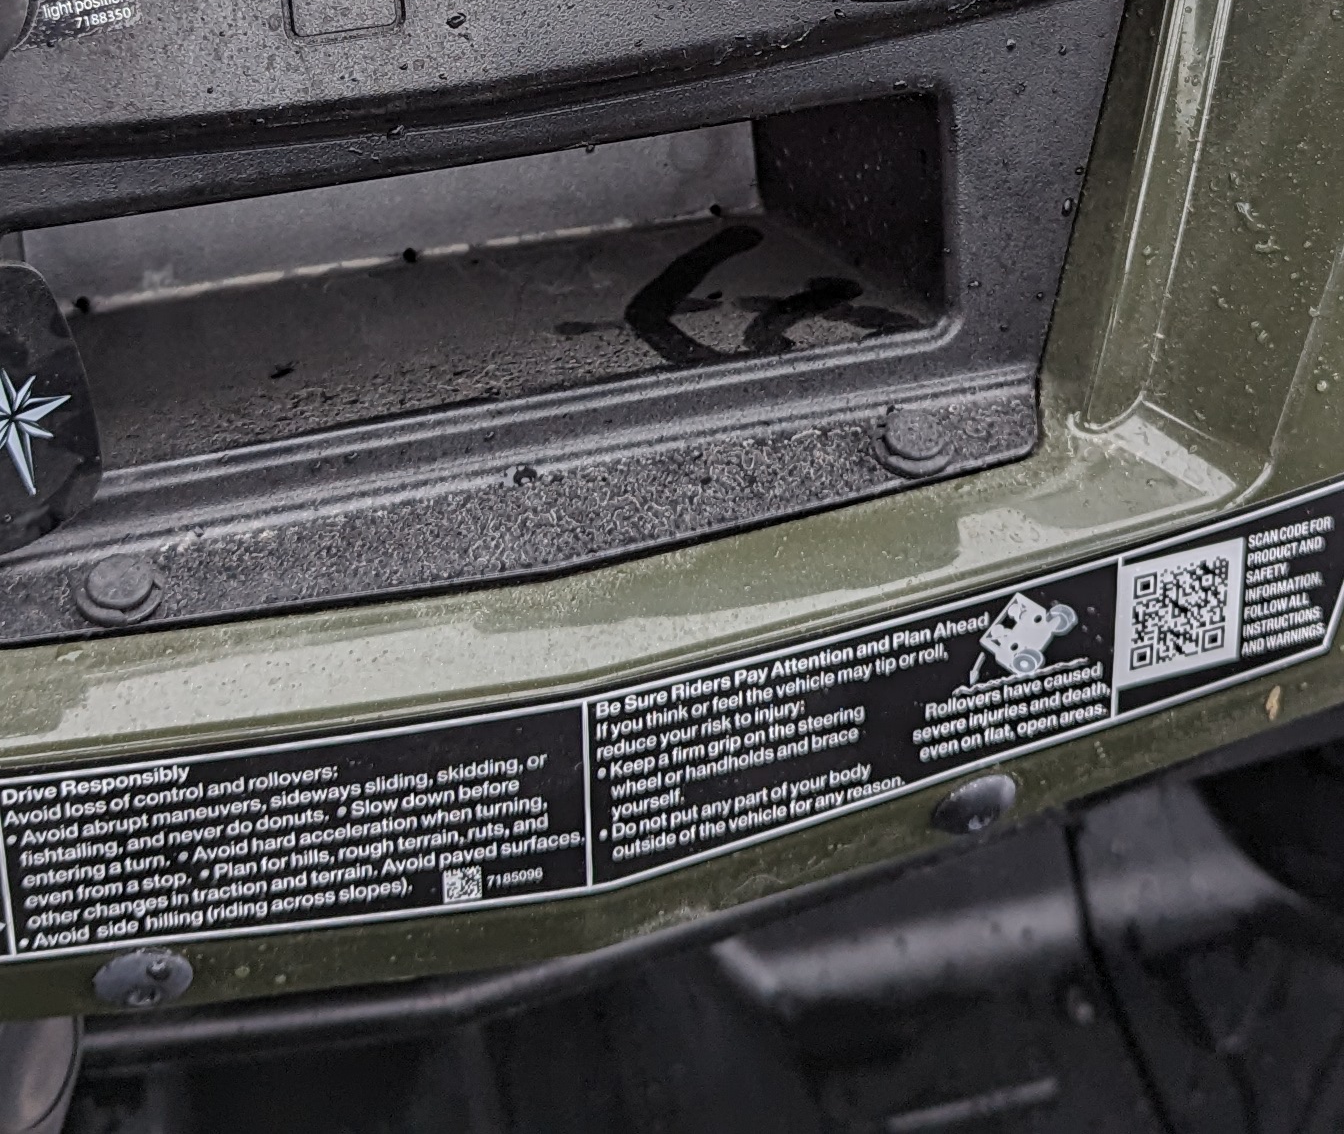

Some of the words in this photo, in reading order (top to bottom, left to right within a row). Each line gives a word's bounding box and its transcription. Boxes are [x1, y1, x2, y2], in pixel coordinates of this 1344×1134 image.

[74, 7, 132, 29] 7188350
[1248, 528, 1278, 548] SCAN
[1279, 521, 1308, 540] CODE
[1309, 516, 1332, 533] FOR
[1247, 541, 1297, 566] PRODUCT
[1298, 535, 1322, 553] AND
[1245, 571, 1321, 602] INFORMATION.
[1246, 561, 1287, 584] SAFETY
[1243, 596, 1287, 619] FOLLOW
[1288, 592, 1309, 608] ALL
[1241, 637, 1264, 654] AND
[596, 700, 621, 718] Be
[624, 690, 667, 712] Sure
[671, 675, 730, 701] Riders
[734, 666, 768, 687] Pay
[770, 647, 853, 678] Attention
[856, 634, 889, 658] and
[892, 628, 930, 649] Plan
[933, 611, 991, 640] Ahead
[596, 721, 607, 740] If
[610, 717, 642, 740] you
[645, 704, 688, 728] think
[691, 701, 709, 717] or
[711, 690, 742, 712] feel
[745, 686, 773, 705] the
[775, 671, 834, 698] vehicle
[837, 662, 872, 682] may
[875, 657, 896, 674] tip
[898, 652, 916, 668] or
[918, 645, 947, 663] roll,
[924, 689, 1001, 720] Rollovers
[1003, 679, 1041, 700] have
[1043, 662, 1102, 690] caused
[912, 717, 966, 743] severe
[968, 702, 1027, 728] injuries
[1029, 693, 1060, 714] and
[1061, 683, 1110, 706] death,
[919, 739, 958, 761] even
[960, 733, 982, 750] on
[983, 724, 1014, 743] flat,
[1016, 714, 1058, 736] open
[1059, 703, 1107, 726] areas.
[1, 785, 57, 805] Drive
[60, 766, 189, 797] Responsibly
[3, 803, 61, 827] Avoid
[64, 800, 106, 817] loss
[109, 792, 130, 811] of
[133, 782, 203, 807] control
[207, 776, 244, 796] and
[20, 822, 78, 846] Avoid
[82, 812, 148, 836] abrupt
[152, 798, 266, 826] maneuvers,
[270, 783, 361, 808] sideways
[364, 772, 433, 793] sliding,
[437, 758, 523, 783] skidding,
[526, 753, 547, 769] or
[611, 788, 684, 821] yourself.
[487, 867, 542, 886] 7185096
[32, 924, 89, 948] Avoid
[96, 918, 138, 938] side
[145, 910, 203, 930] hilling
[206, 900, 267, 923] (riding
[270, 890, 335, 912] across
